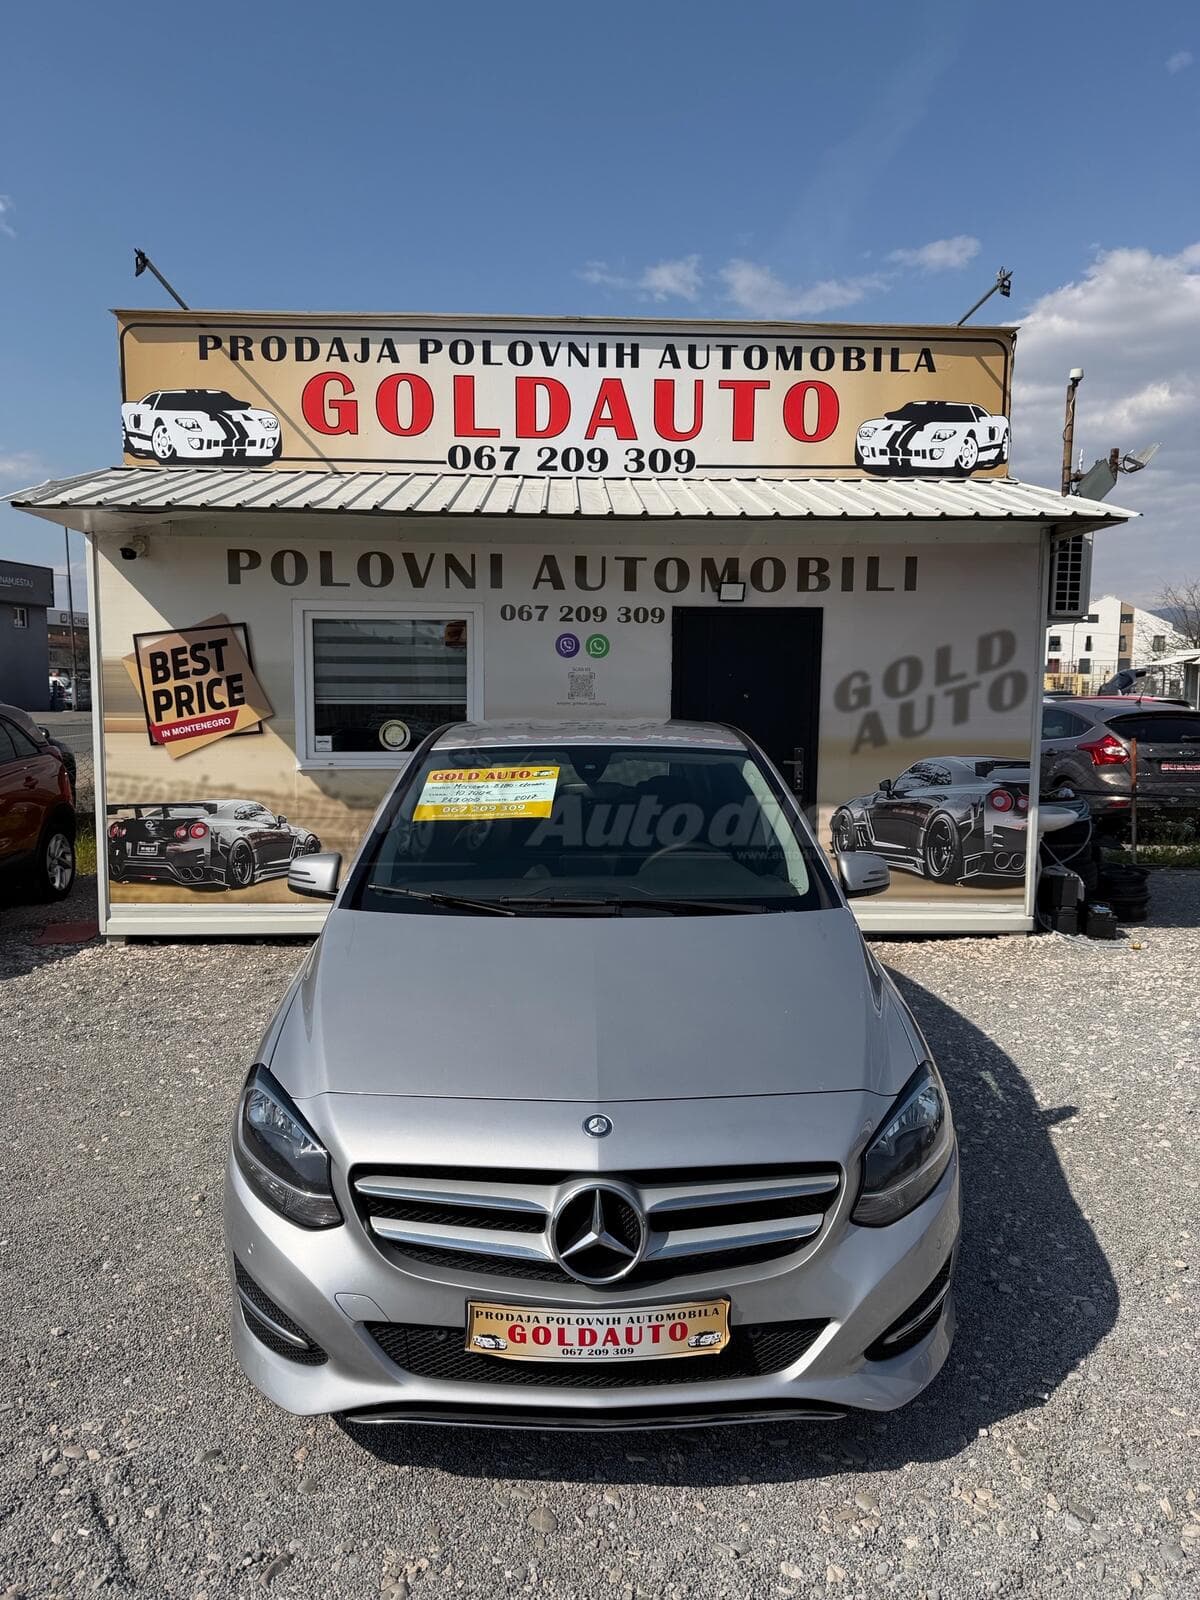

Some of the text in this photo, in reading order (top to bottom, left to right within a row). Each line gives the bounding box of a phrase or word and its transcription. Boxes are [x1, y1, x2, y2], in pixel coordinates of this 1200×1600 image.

[198, 334, 937, 374] PRODAJA POLOVNIH AUTOMOBILA
[301, 371, 840, 443] GOLDAUTO
[447, 445, 697, 474] 067 209 309
[227, 548, 918, 593] POLOVNI AUTOMOBILI
[500, 604, 666, 624] 067 209 309
[150, 638, 228, 685] BEST
[834, 629, 1017, 714] GOLD
[152, 673, 246, 723] PRICE
[851, 670, 1029, 754] AUTO
[161, 717, 231, 738] IN MONTENEGRO
[432, 770, 532, 781] GOLD AUTO
[472, 805, 497, 813] 209
[475, 1307, 720, 1326] PRODAJA POLOVNIH AUTOMOBILA
[507, 1321, 689, 1348] GOLDAUTO
[562, 1347, 634, 1356] 067 209 309
